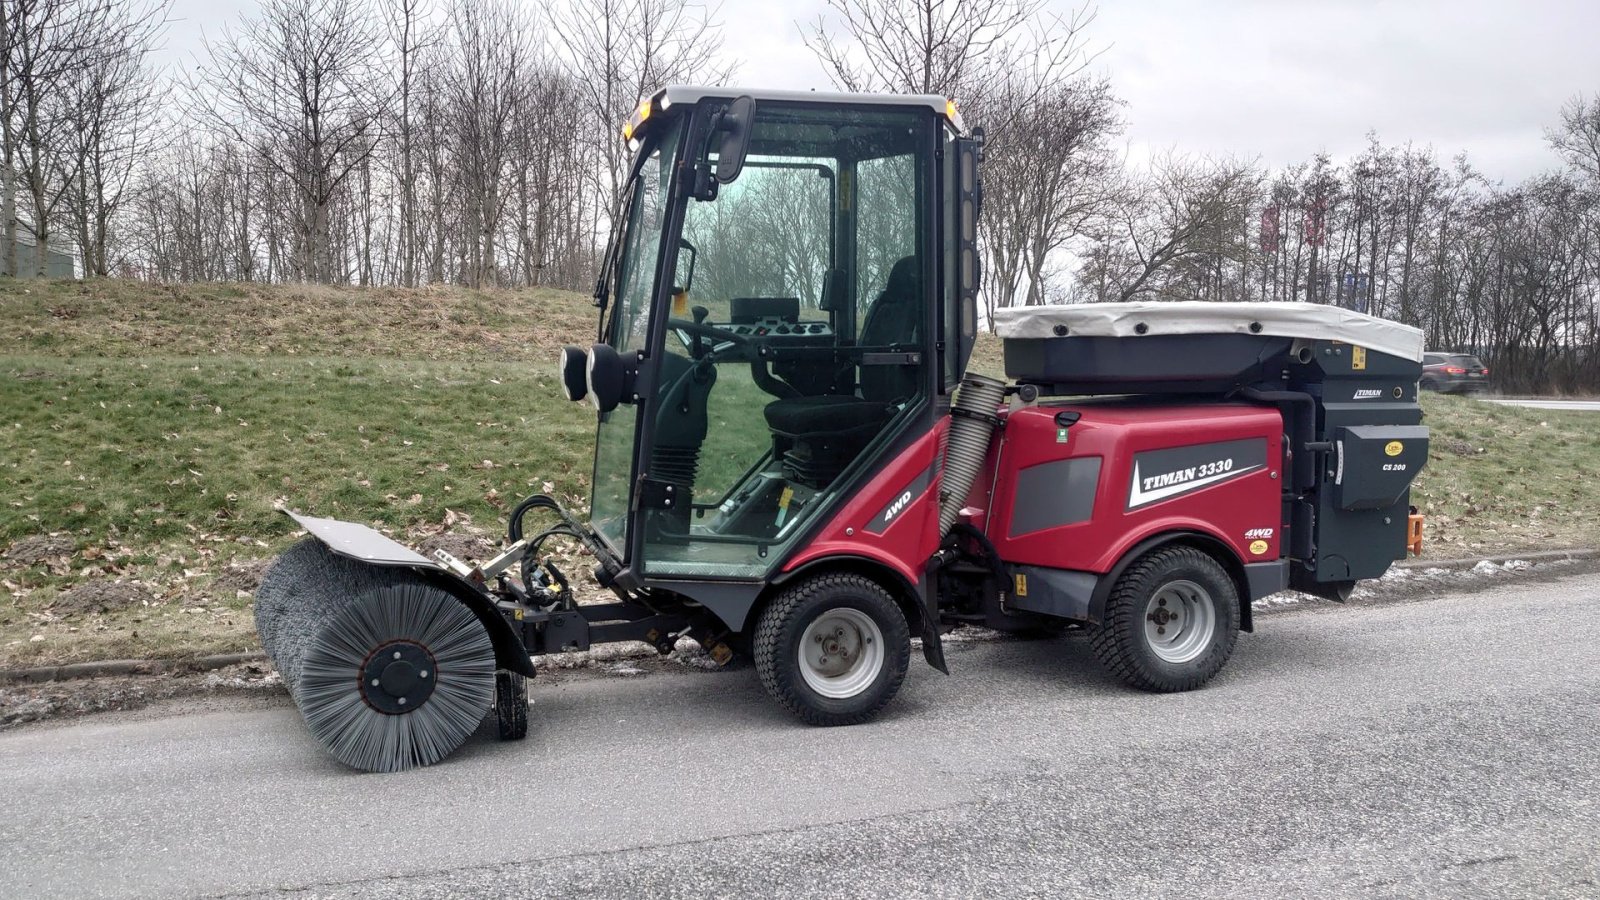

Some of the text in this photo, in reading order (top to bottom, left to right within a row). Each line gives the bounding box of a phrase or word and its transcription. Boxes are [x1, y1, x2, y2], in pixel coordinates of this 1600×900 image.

[1143, 458, 1233, 490] TIMAN 3330
[1382, 463, 1406, 471] CS 200
[884, 490, 912, 522] 4WD
[1244, 528, 1274, 536] 4WD
